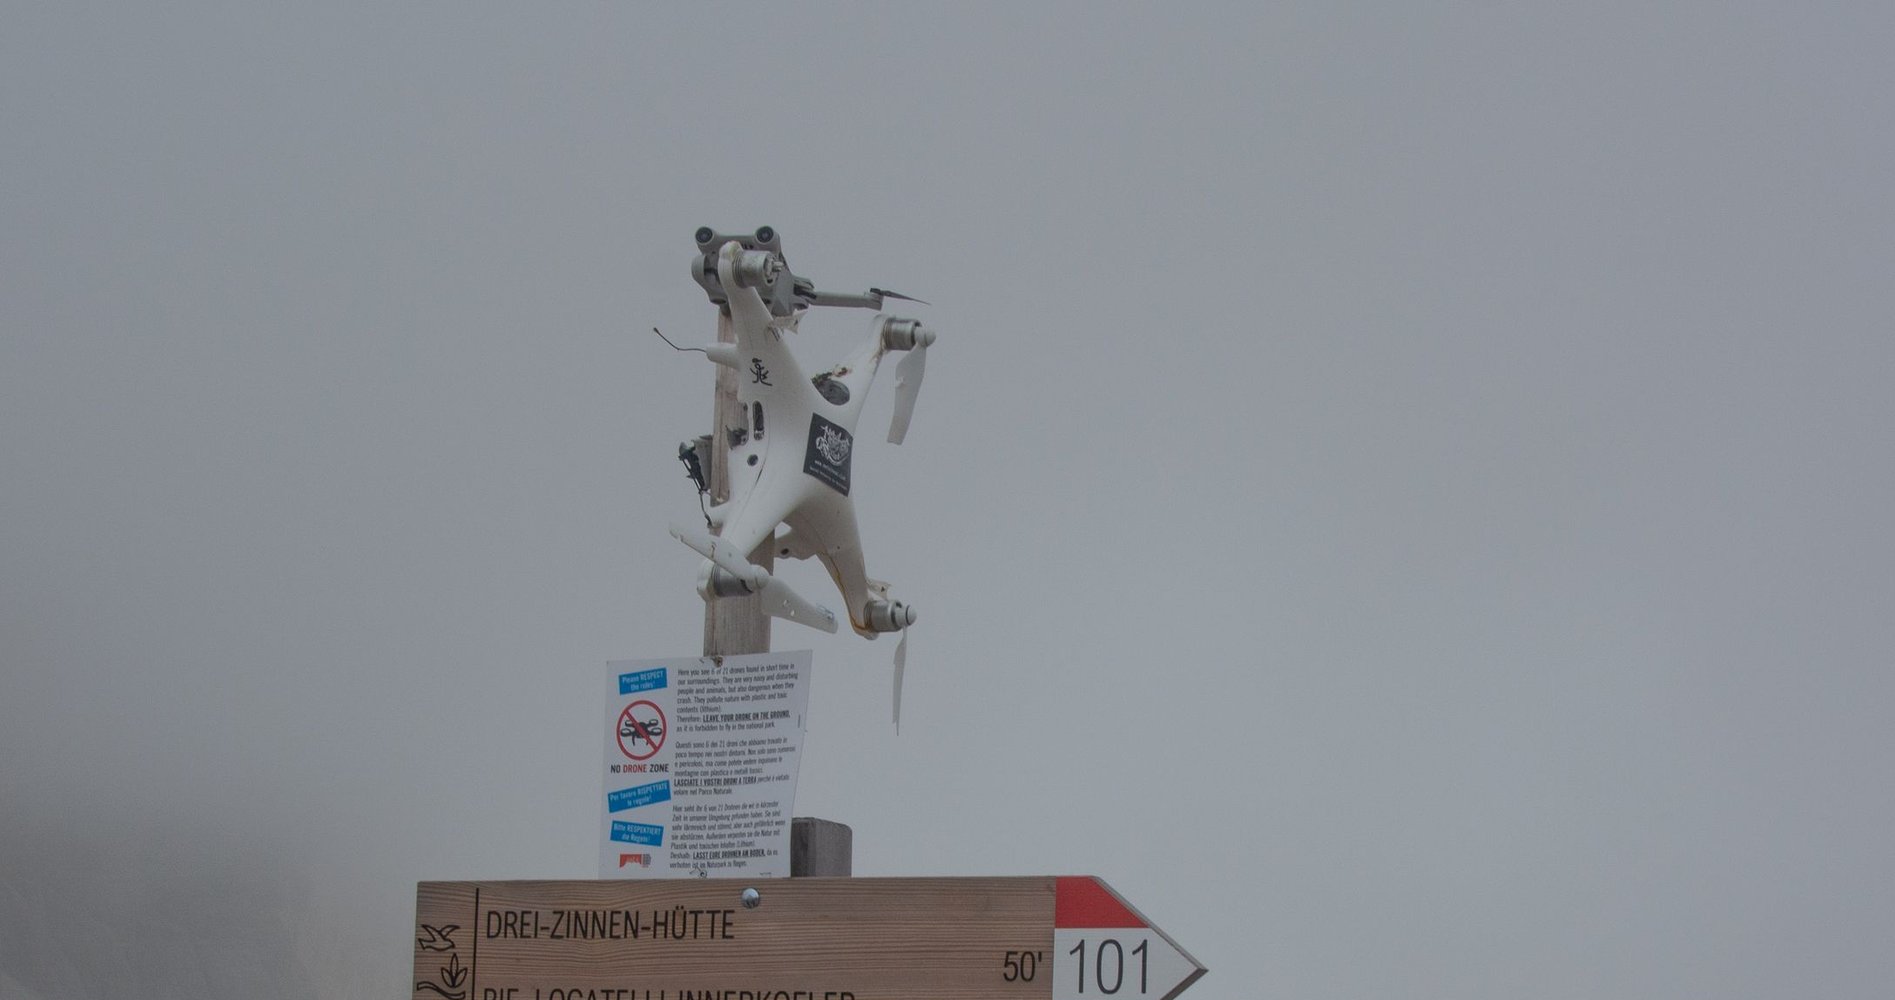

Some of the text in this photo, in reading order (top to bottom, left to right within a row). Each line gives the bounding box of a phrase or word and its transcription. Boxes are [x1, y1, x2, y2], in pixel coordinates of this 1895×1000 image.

[640, 670, 663, 680] RESPECT
[610, 764, 669, 773] NO DRONE ZONE
[627, 824, 661, 835] RESPEKTIERT
[486, 905, 736, 940] DREI-ZINNEN-HÜTTE
[1003, 950, 1043, 983] 50'
[1069, 938, 1148, 995] 101
